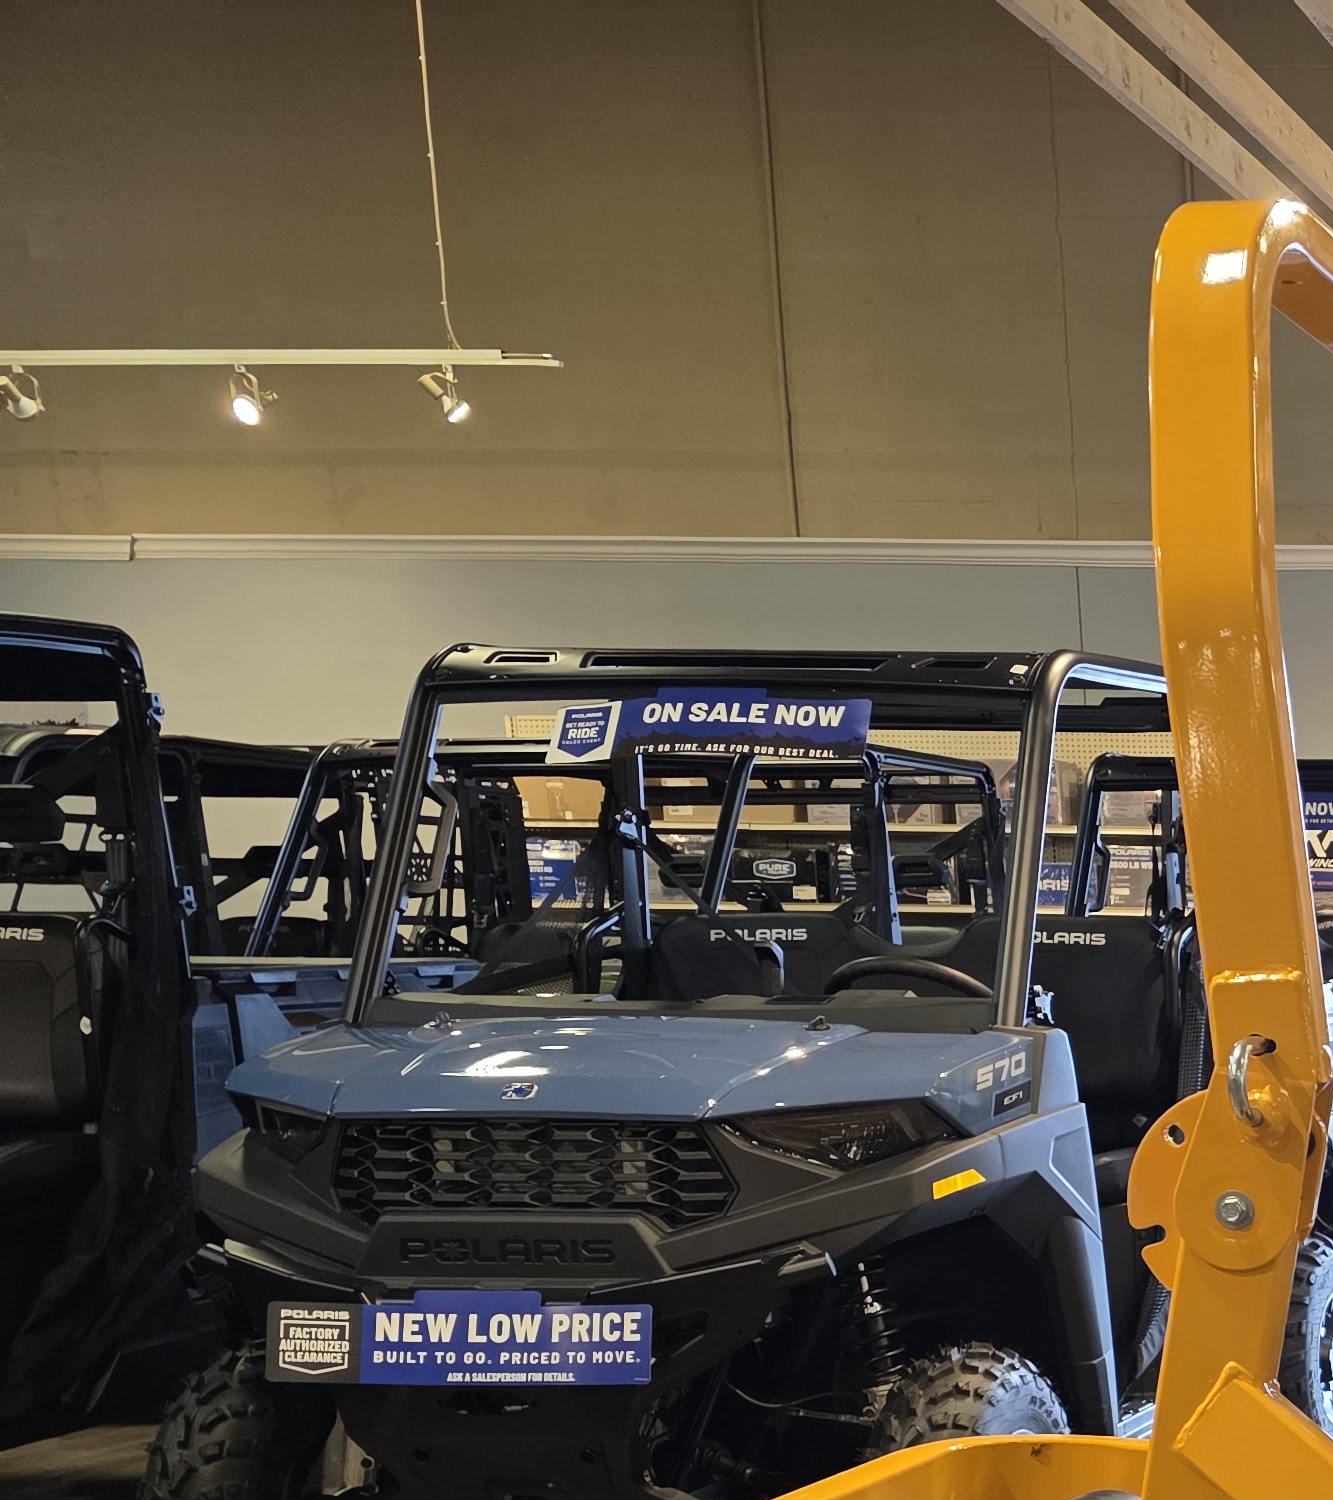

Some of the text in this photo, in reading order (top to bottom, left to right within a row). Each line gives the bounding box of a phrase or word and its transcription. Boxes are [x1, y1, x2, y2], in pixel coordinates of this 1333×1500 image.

[642, 702, 846, 727] ON SALE NOW
[567, 726, 600, 740] RIDE
[634, 744, 654, 754] IT'S
[674, 743, 701, 752] TIME.
[705, 743, 726, 753] ASK
[729, 744, 750, 753] FOR
[753, 745, 774, 755] OUR
[778, 747, 805, 756] BEST
[758, 863, 791, 871] PURE
[976, 1051, 1026, 1091] 570
[1003, 1091, 1023, 1105] EFI
[400, 1238, 616, 1266] POLARIS
[280, 1308, 350, 1320] POLARIS
[289, 1326, 340, 1340] FACTORY
[374, 1311, 642, 1344] NEW LOW PRICE
[279, 1338, 350, 1353] AUTHORIZED
[284, 1351, 344, 1364] CLEARANCE
[373, 1350, 641, 1365] BUILT TO GO. PRICED TO MOVE.
[447, 1372, 576, 1383] ASK A SALESPERSON FOR DETAILS.
